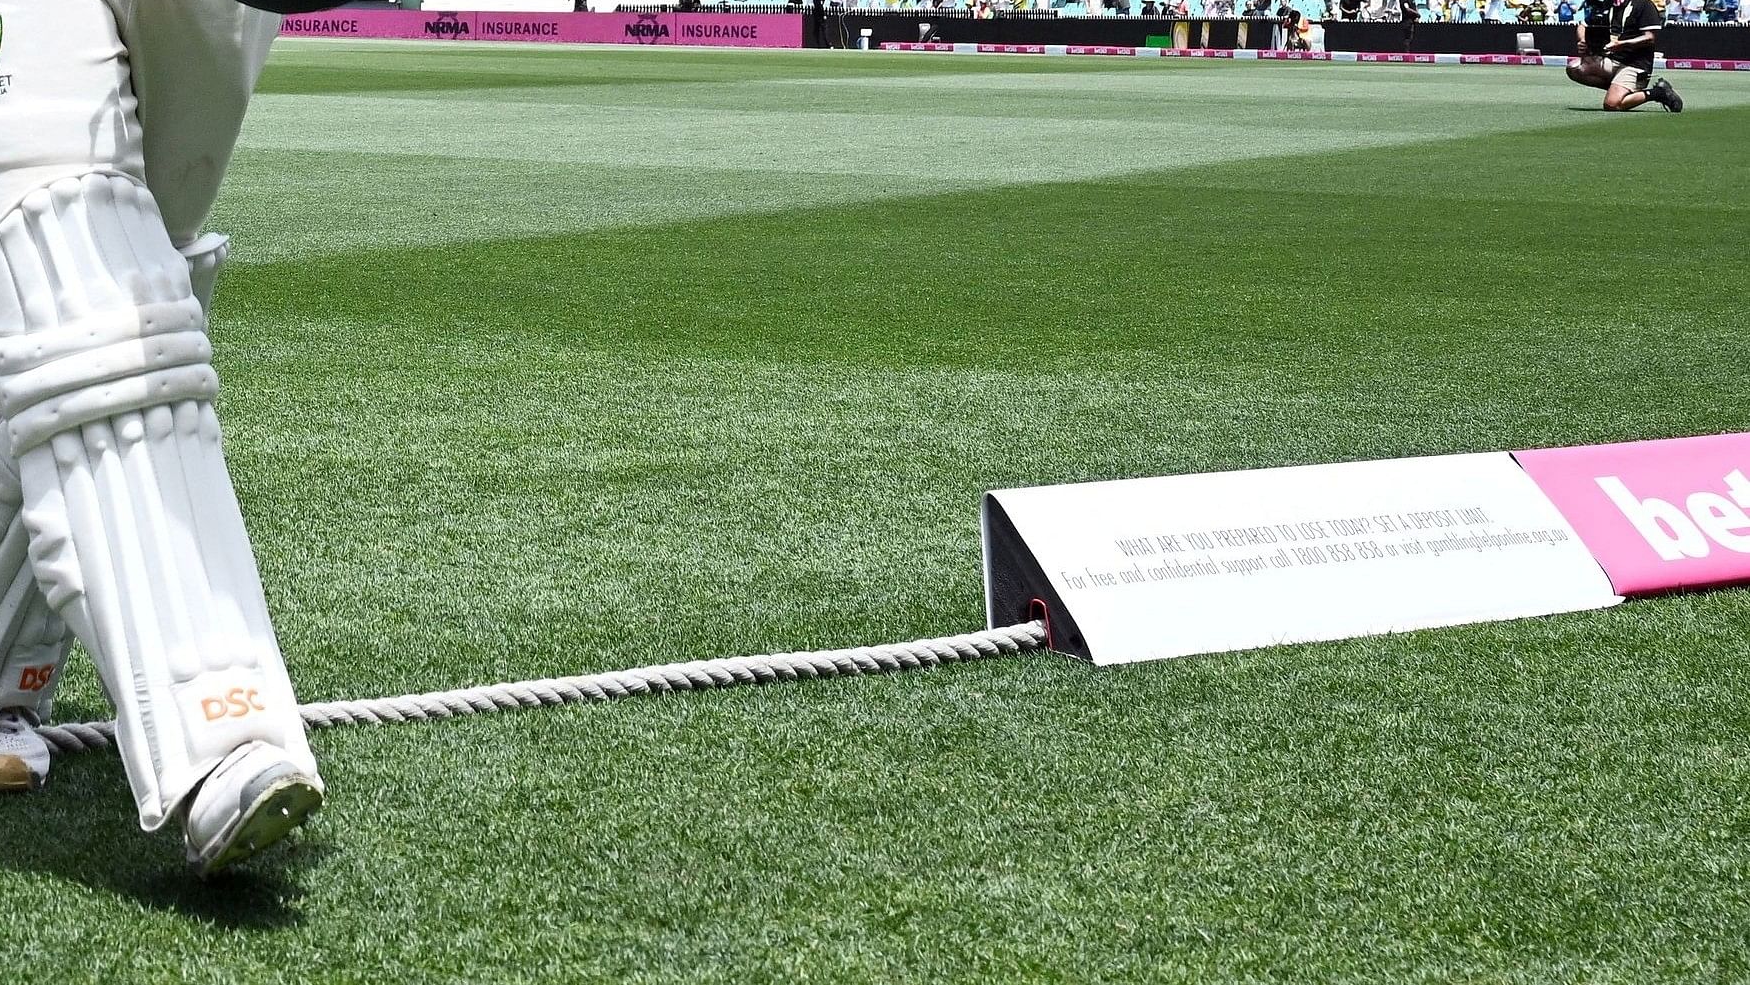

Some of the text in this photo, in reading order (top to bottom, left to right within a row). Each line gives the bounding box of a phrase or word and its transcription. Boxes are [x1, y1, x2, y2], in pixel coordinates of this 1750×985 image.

[281, 19, 358, 32] INSURANCE
[424, 21, 559, 36] NRMA INSURANCE
[624, 24, 758, 39] NRMA INSURANCE
[1114, 537, 1158, 558] WHAT
[1156, 534, 1185, 554] ARE
[1184, 531, 1214, 550] YOU
[1212, 526, 1278, 549] PREPARED
[1276, 524, 1298, 542] TO
[1296, 521, 1330, 540] LOSE
[1326, 517, 1374, 536] TODAY?
[1373, 514, 1399, 533] SET
[1398, 514, 1411, 530] A
[1407, 510, 1458, 530] DEPOSIT
[1060, 527, 1570, 590] For free and confidential support call 1800 858 858 or visit gamblinghelponline.org.au
[201, 688, 266, 722] DSC
